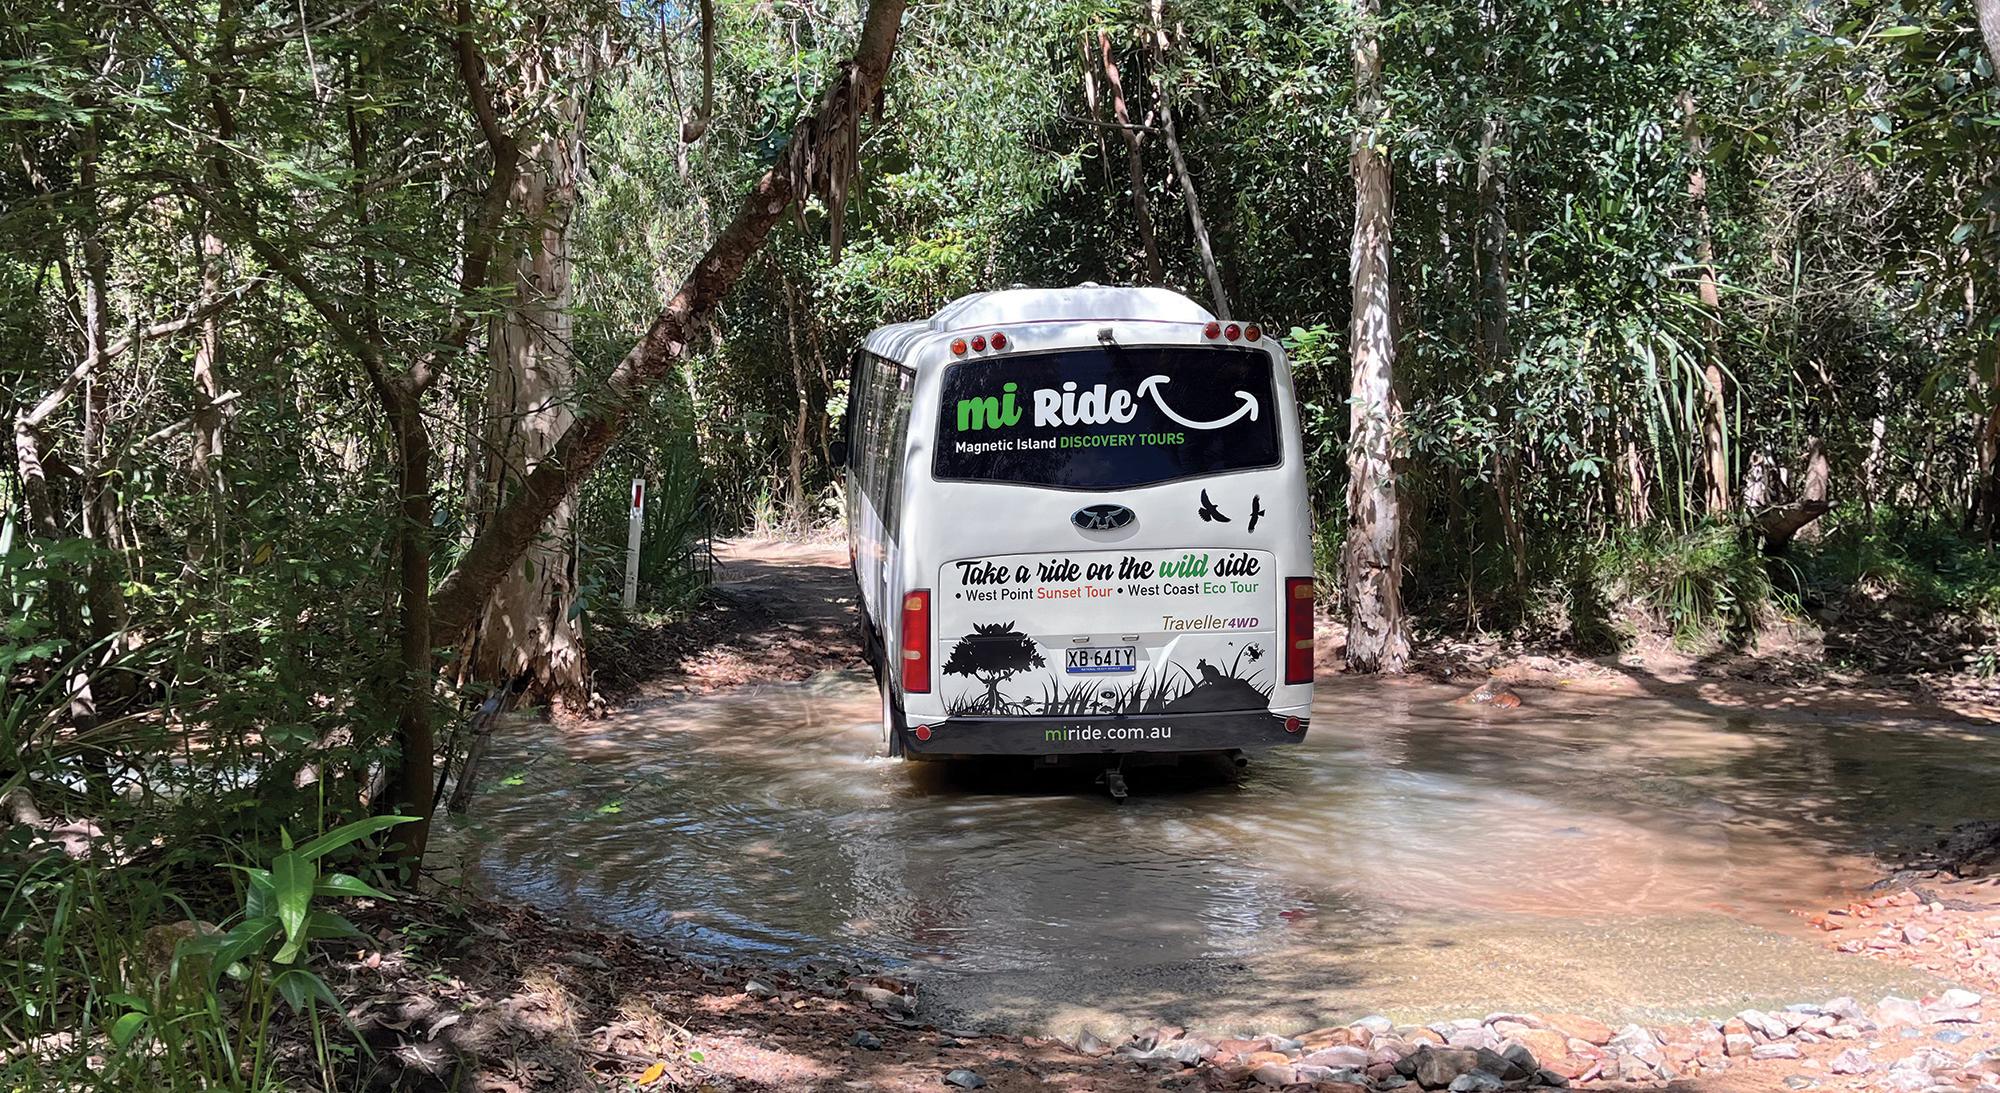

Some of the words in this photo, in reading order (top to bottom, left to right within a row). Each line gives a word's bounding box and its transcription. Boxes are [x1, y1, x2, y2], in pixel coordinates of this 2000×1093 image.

[957, 382, 1022, 431] mi
[1033, 381, 1138, 427] Ride
[955, 439, 1014, 455] Magnetic
[1016, 436, 1057, 451] Island
[1060, 433, 1135, 449] DISCOVERY
[1138, 432, 1185, 445] TOURS
[956, 561, 1010, 586] Take
[1015, 566, 1030, 583] a
[1036, 559, 1081, 583] ride
[1086, 562, 1115, 580] on
[1118, 556, 1154, 581] the
[1158, 553, 1208, 578] wild
[1213, 552, 1260, 577] side
[965, 589, 999, 602] West
[1001, 587, 1034, 600] Point
[1037, 586, 1081, 600] Sunset
[1085, 585, 1113, 598] Tour
[1128, 583, 1160, 596] West
[1163, 582, 1200, 595] Coast
[1203, 581, 1227, 594] Eco
[1230, 581, 1259, 593] Tour
[1045, 725, 1172, 741] miride.com.au
